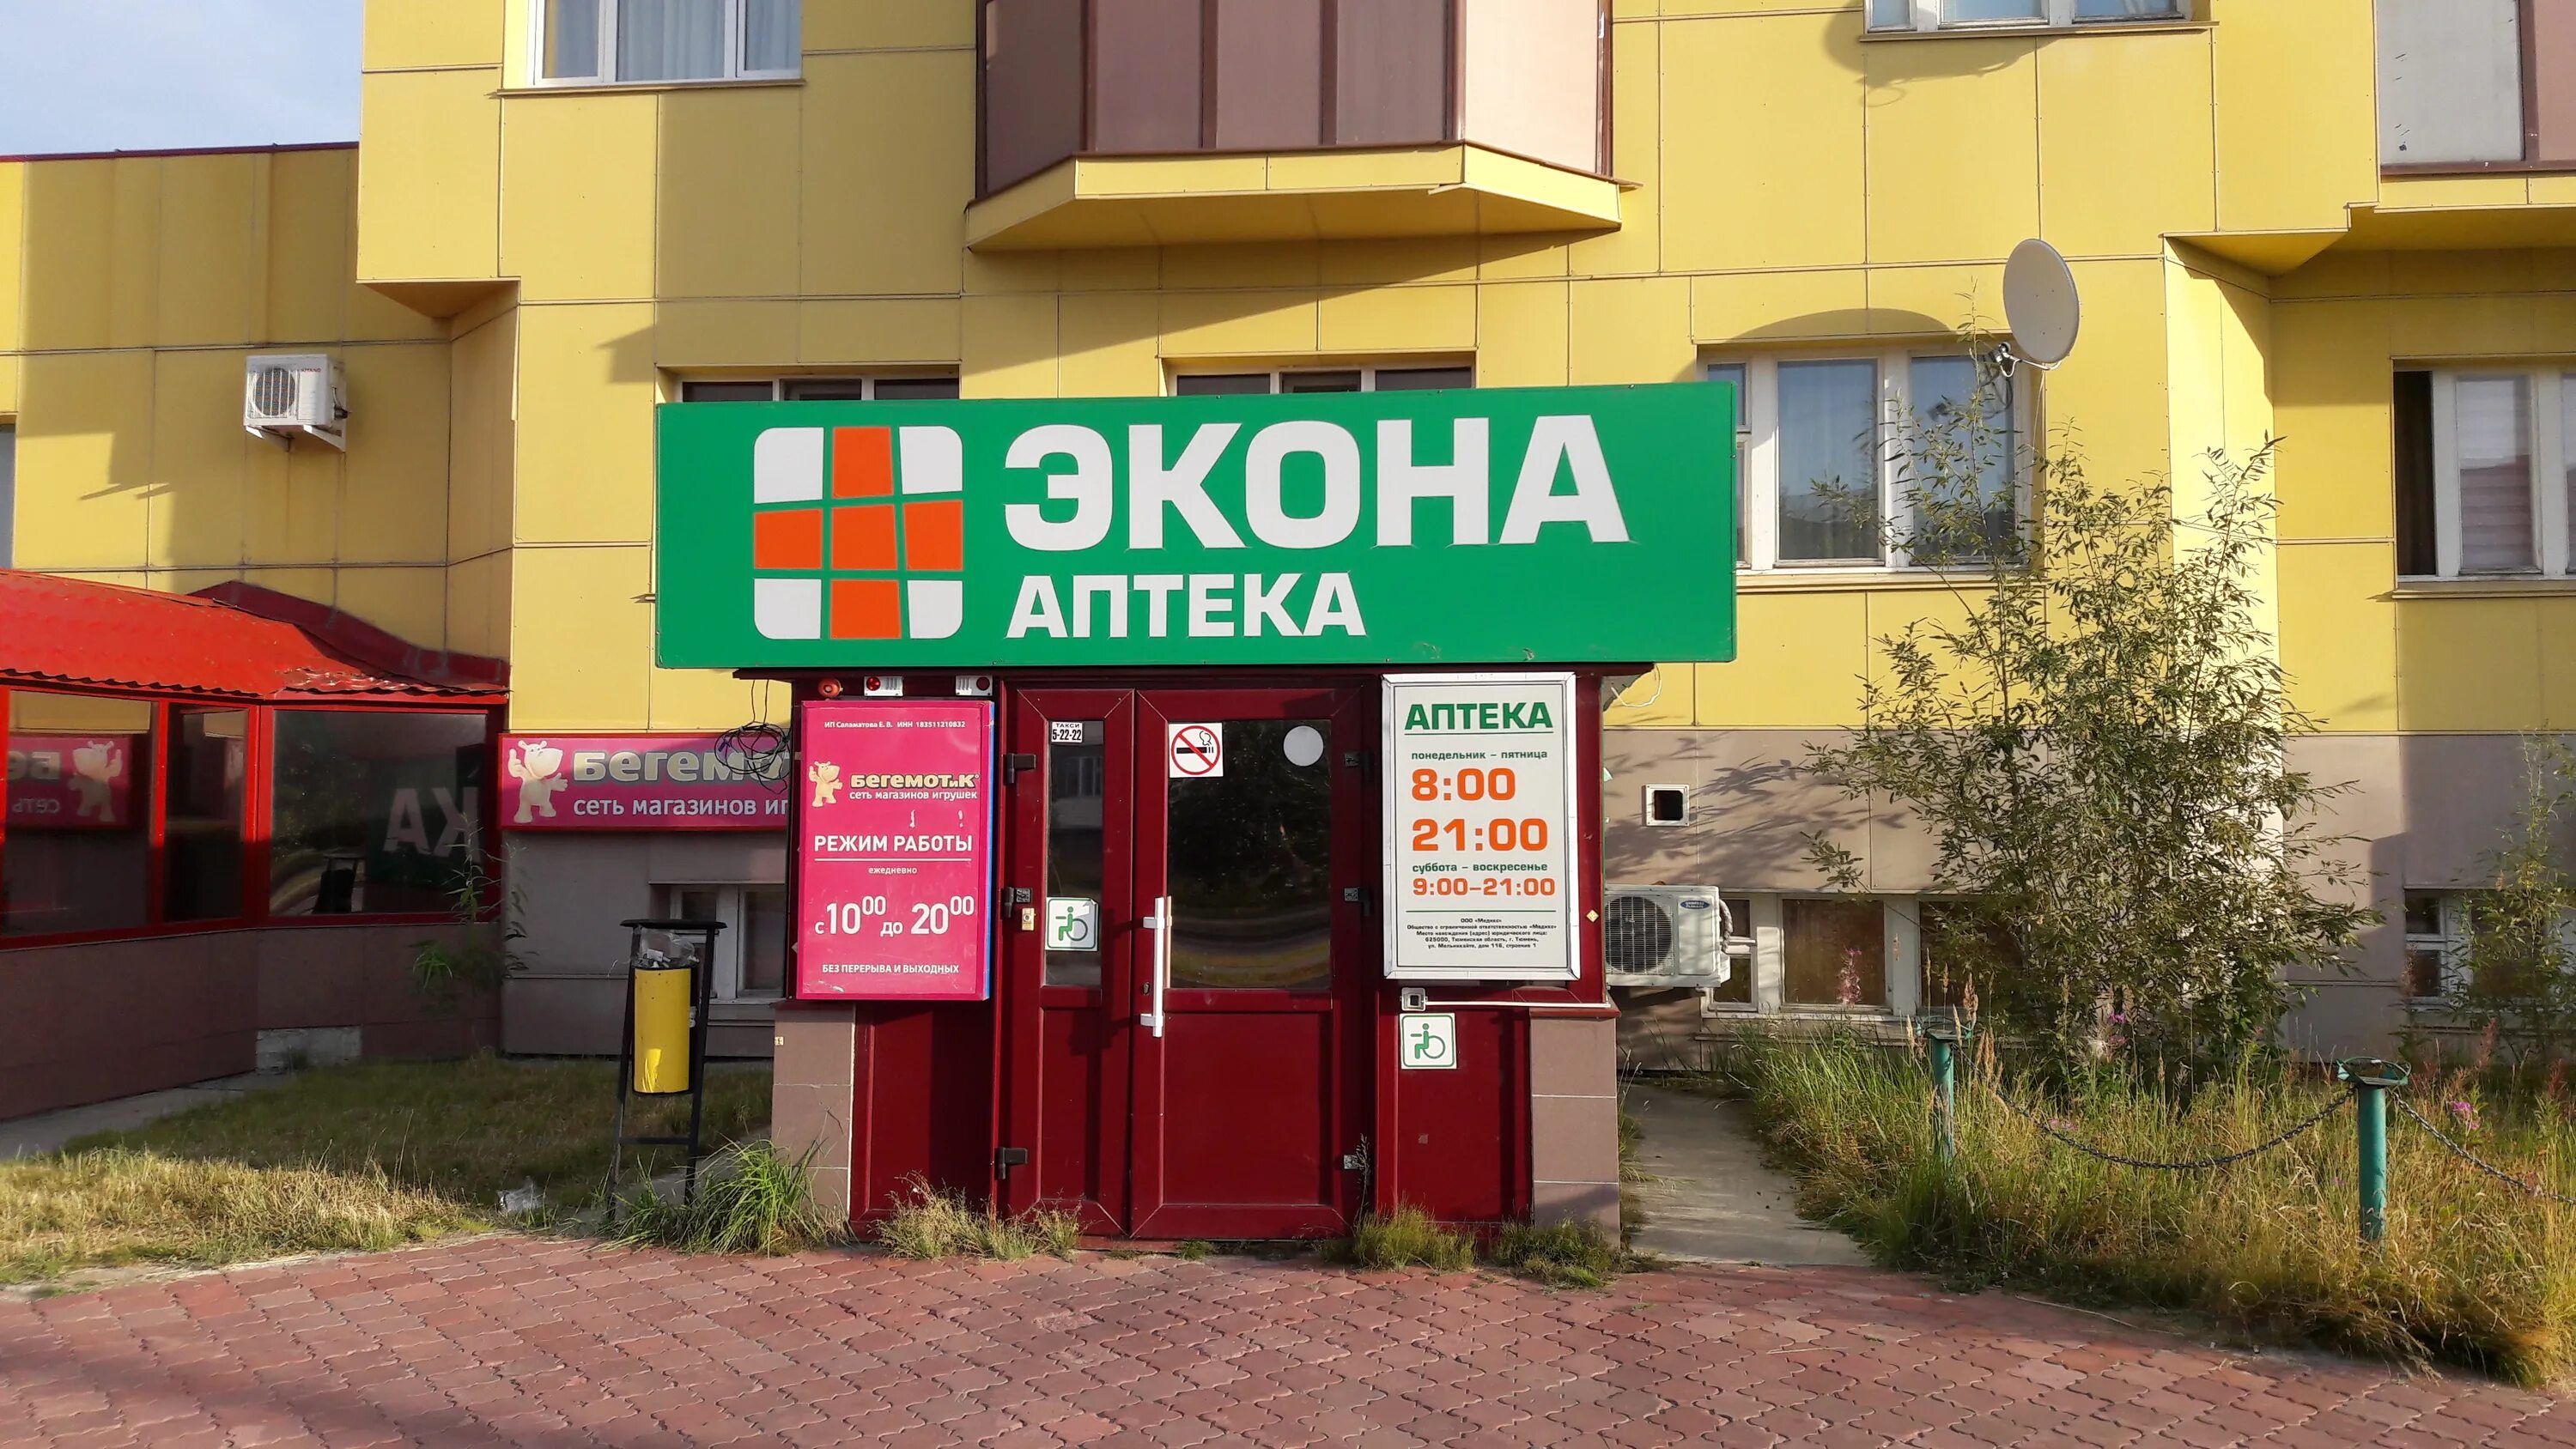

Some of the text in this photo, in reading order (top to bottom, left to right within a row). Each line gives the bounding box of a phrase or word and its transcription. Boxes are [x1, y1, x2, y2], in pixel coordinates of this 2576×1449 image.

[1005, 414, 1631, 552] ЭКОНА
[1005, 572, 1367, 639] АПТЕКА
[1405, 701, 1553, 731] АПТЕКА
[1052, 729, 1082, 741] 5-22-22
[1412, 752, 1485, 761] понедельник
[1501, 750, 1547, 760] пятница
[573, 750, 789, 781] Бегемо
[1412, 768, 1516, 801] 8:00
[932, 791, 978, 801] игрушек
[574, 799, 624, 815] сеть
[632, 799, 757, 815] магазинов
[1413, 818, 1548, 852] 21:00
[814, 835, 973, 852] РЕЖИМ РАБОТЫ
[1413, 863, 1458, 874] суббота
[1473, 863, 1548, 873] воскресенье
[815, 922, 825, 934] с
[880, 922, 903, 937] до
[822, 965, 959, 974] БЕЗ ПЕРЕРЫВА И ВЫХОДНЫХ
